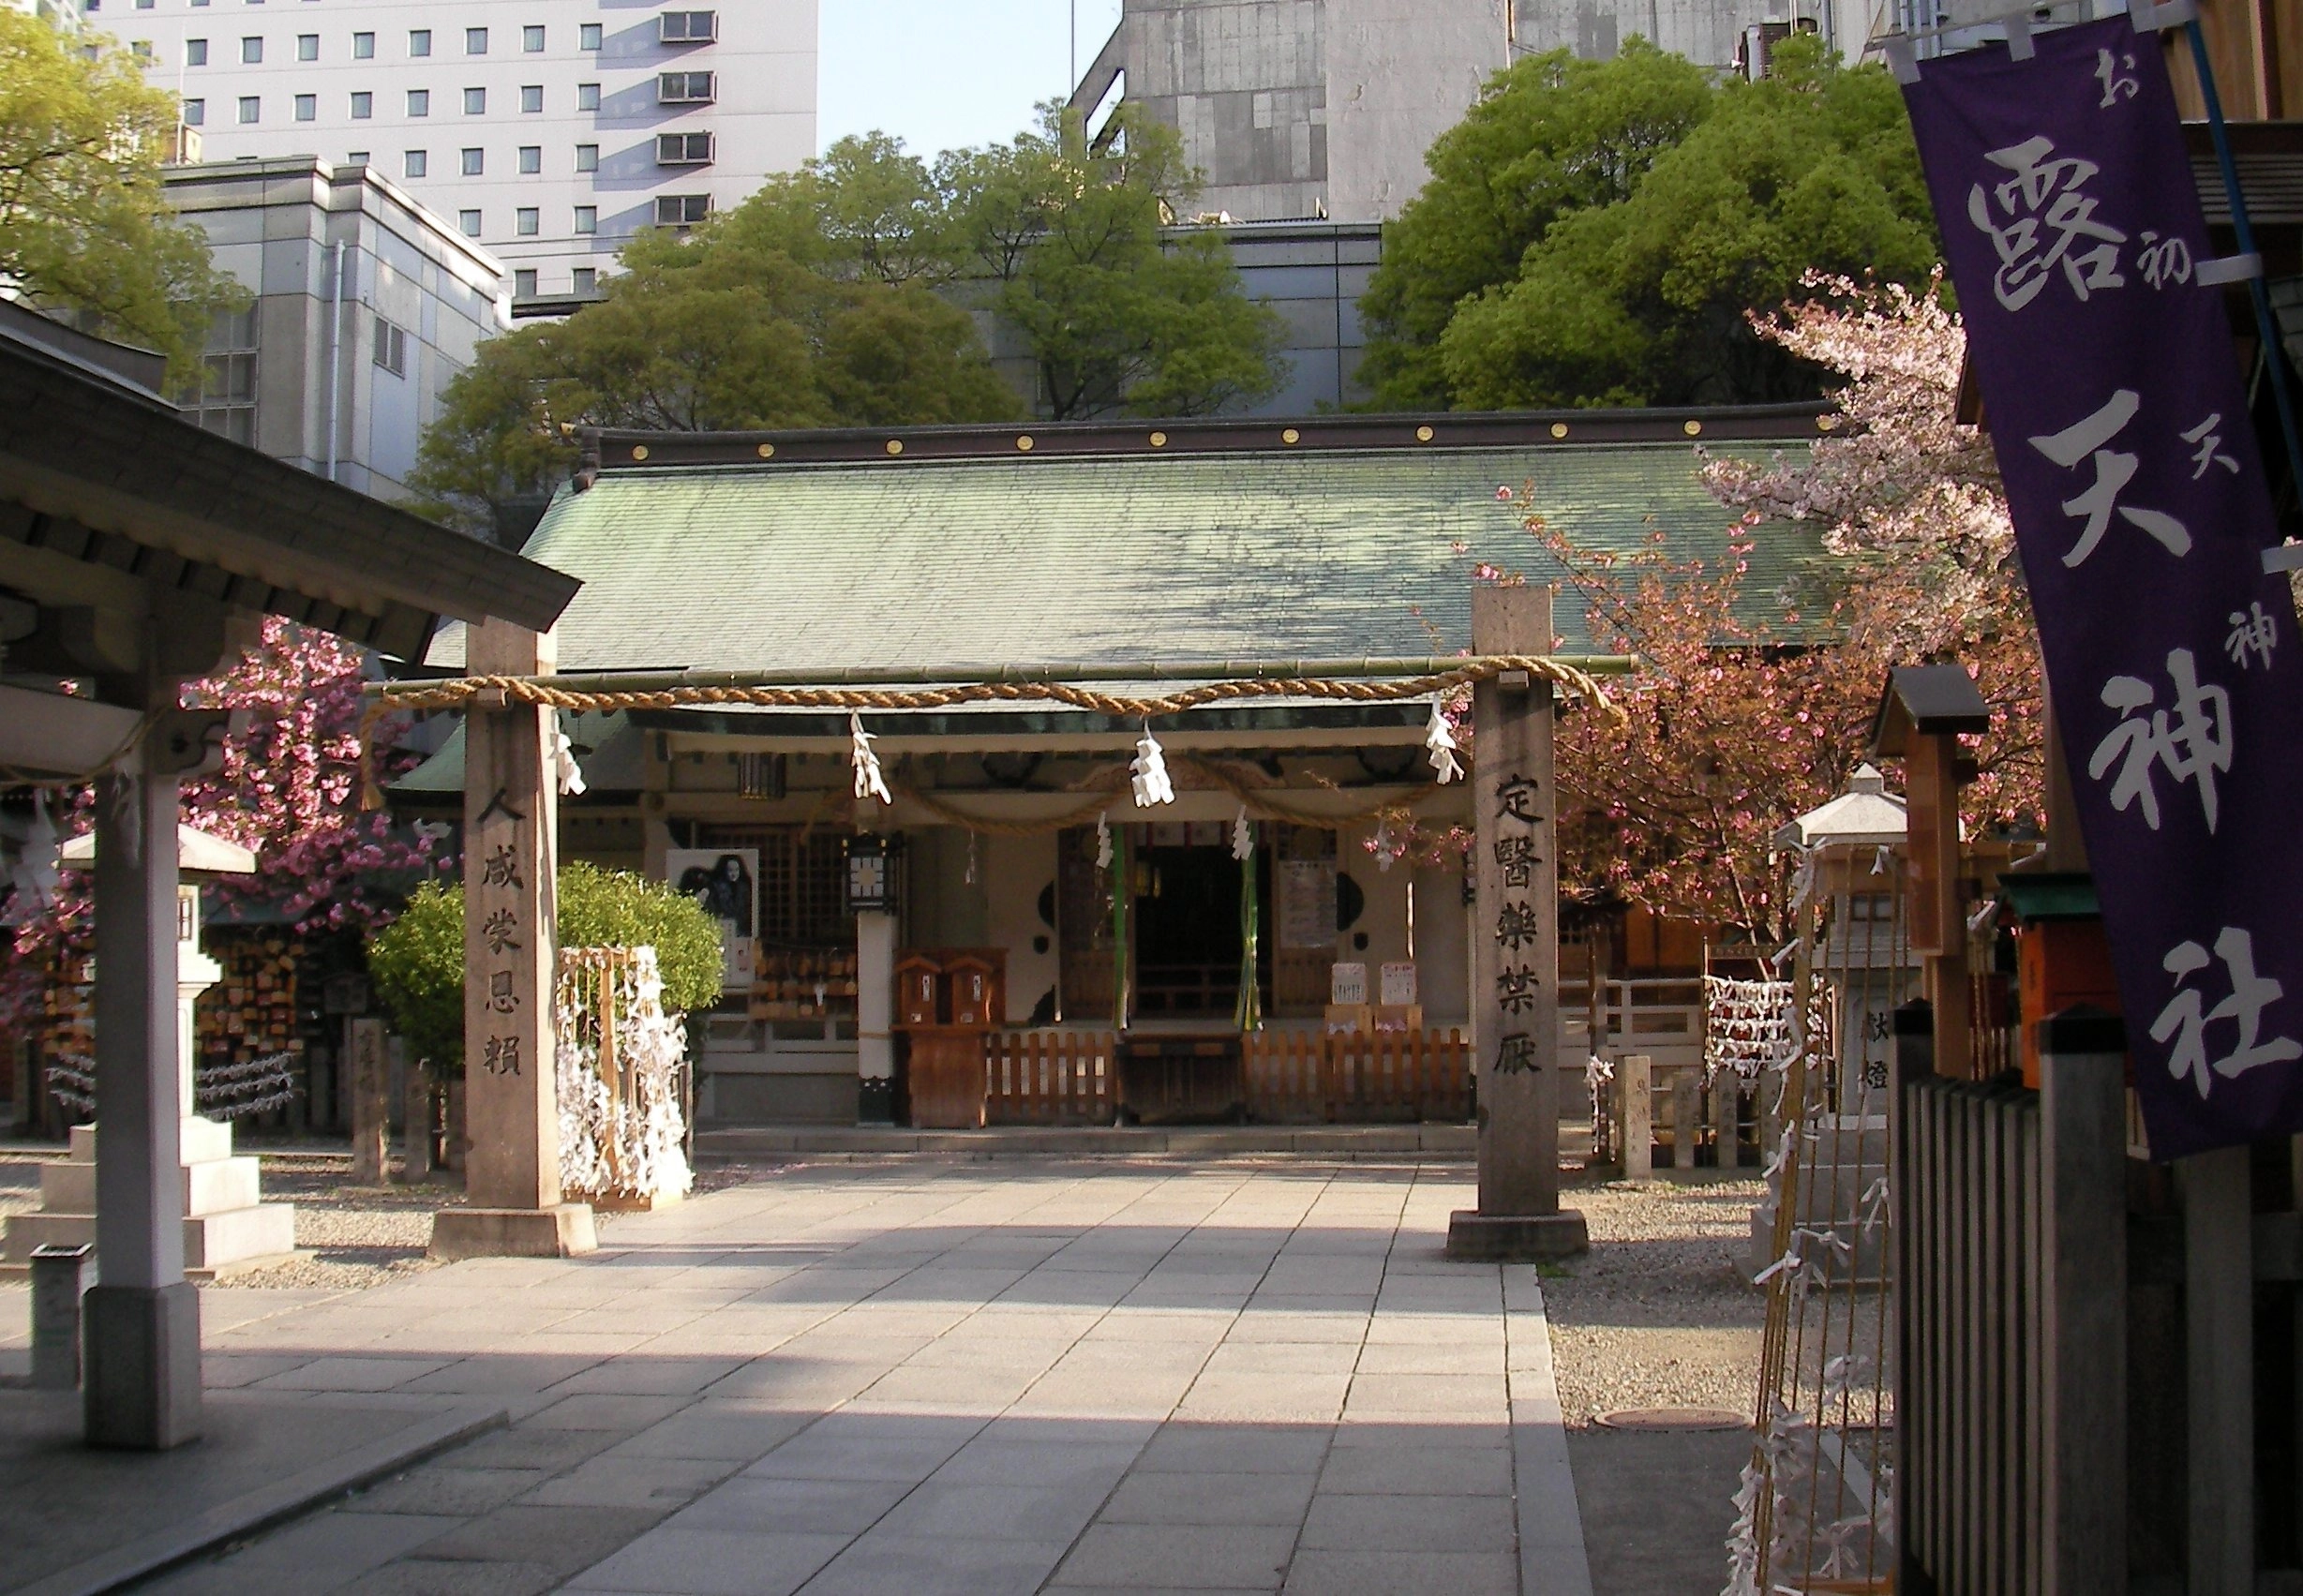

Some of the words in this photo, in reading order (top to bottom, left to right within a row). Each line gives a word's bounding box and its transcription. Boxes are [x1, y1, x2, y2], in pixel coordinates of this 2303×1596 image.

[1967, 135, 2303, 1100] 露天神社
[2094, 48, 2278, 670] お初天神
